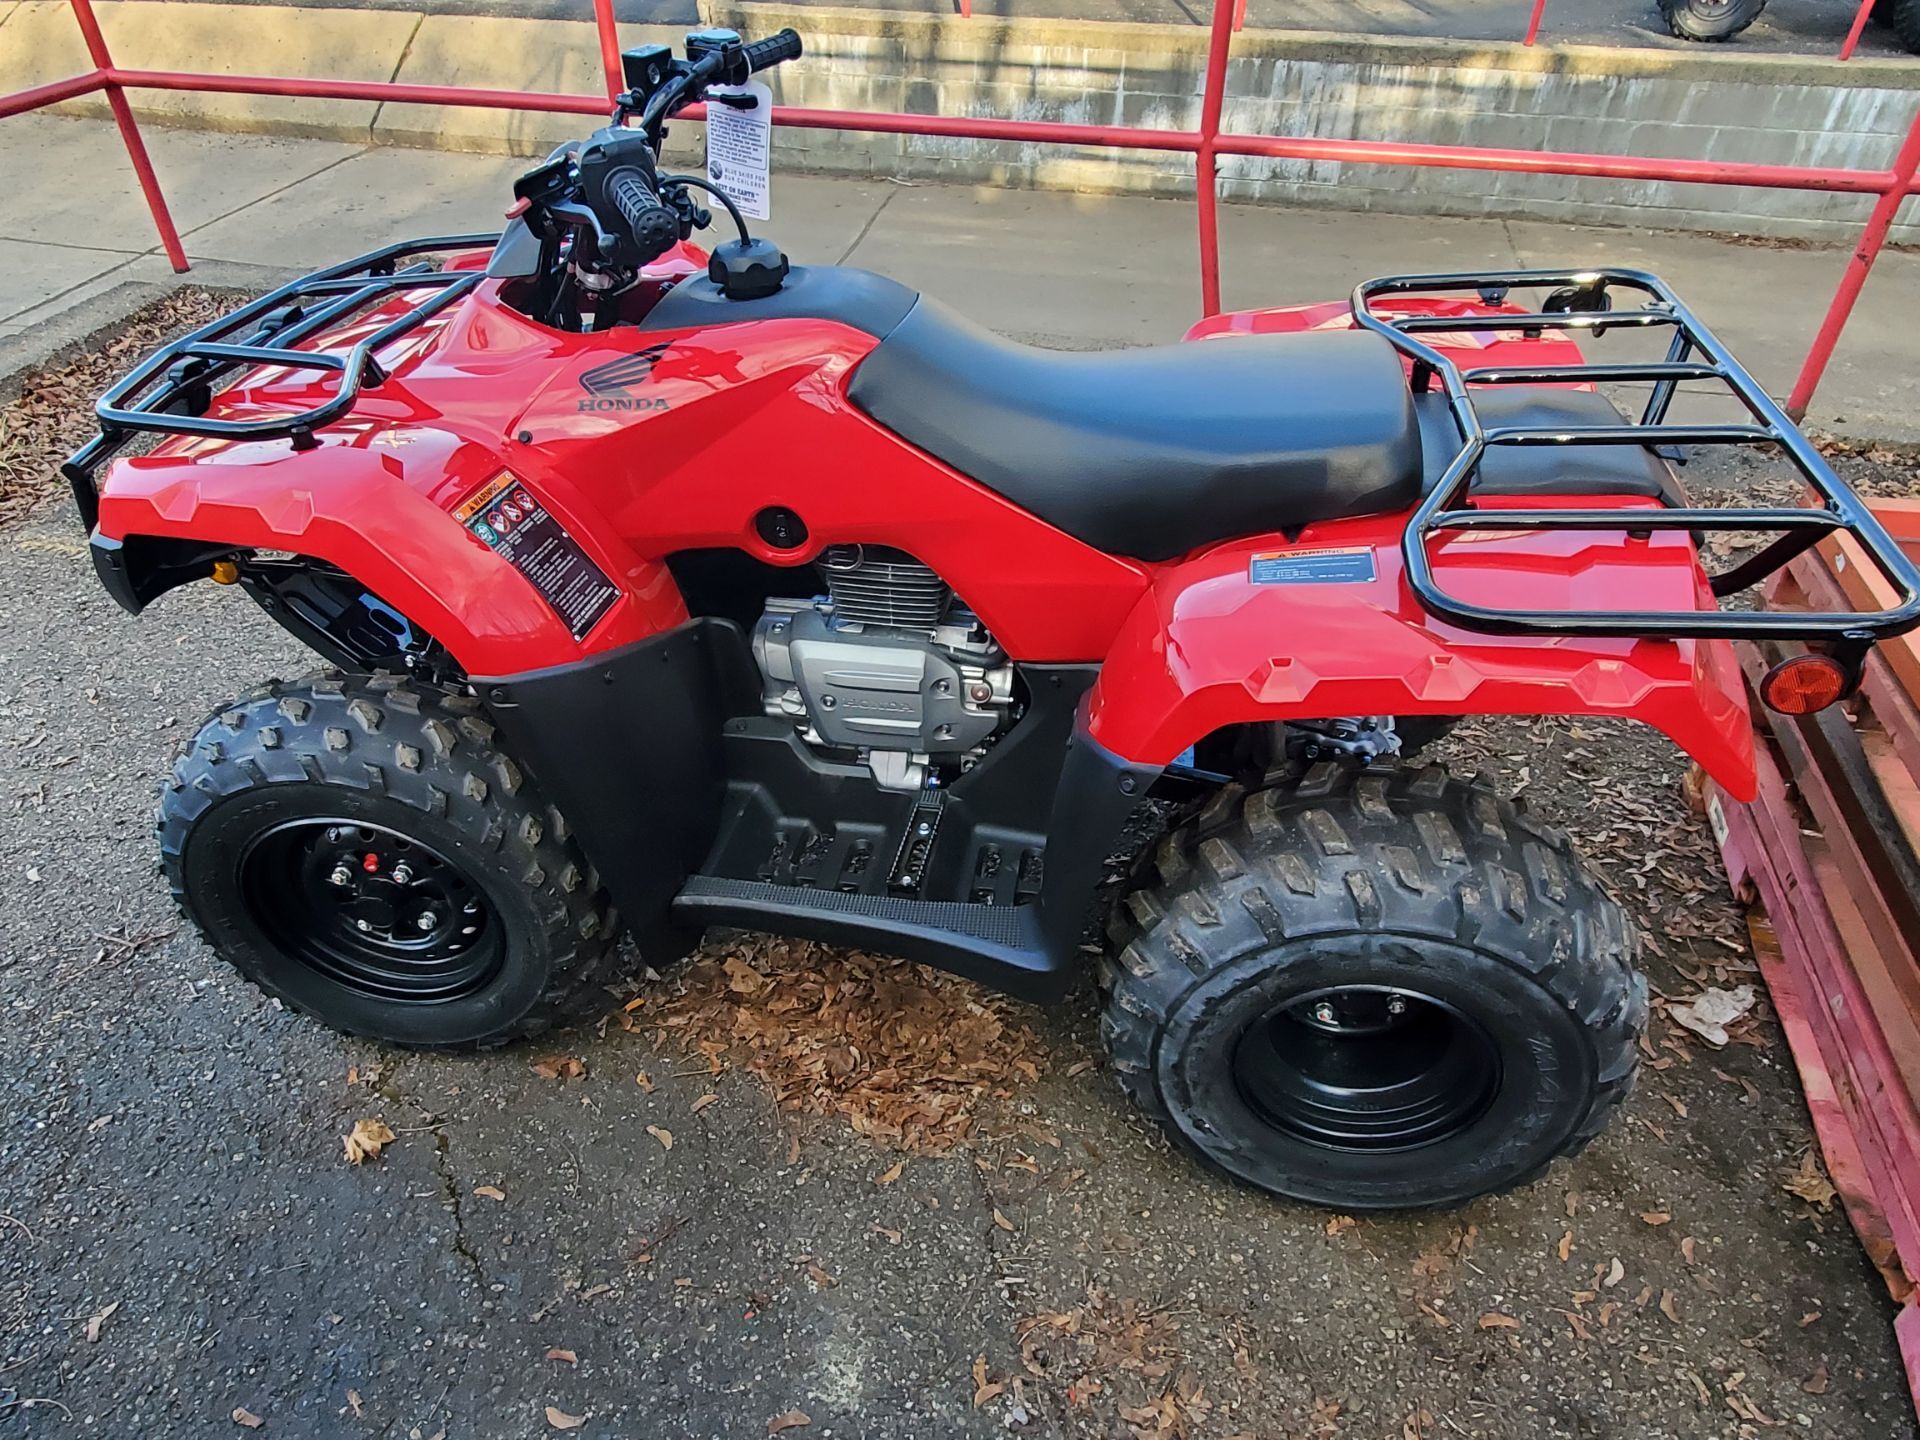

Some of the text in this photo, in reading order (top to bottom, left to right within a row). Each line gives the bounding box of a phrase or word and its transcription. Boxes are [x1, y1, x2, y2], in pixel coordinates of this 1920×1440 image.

[577, 398, 670, 412] HONDA
[472, 482, 501, 506] WARNING
[1290, 549, 1345, 557] WARNING
[842, 697, 915, 713] HONDA
